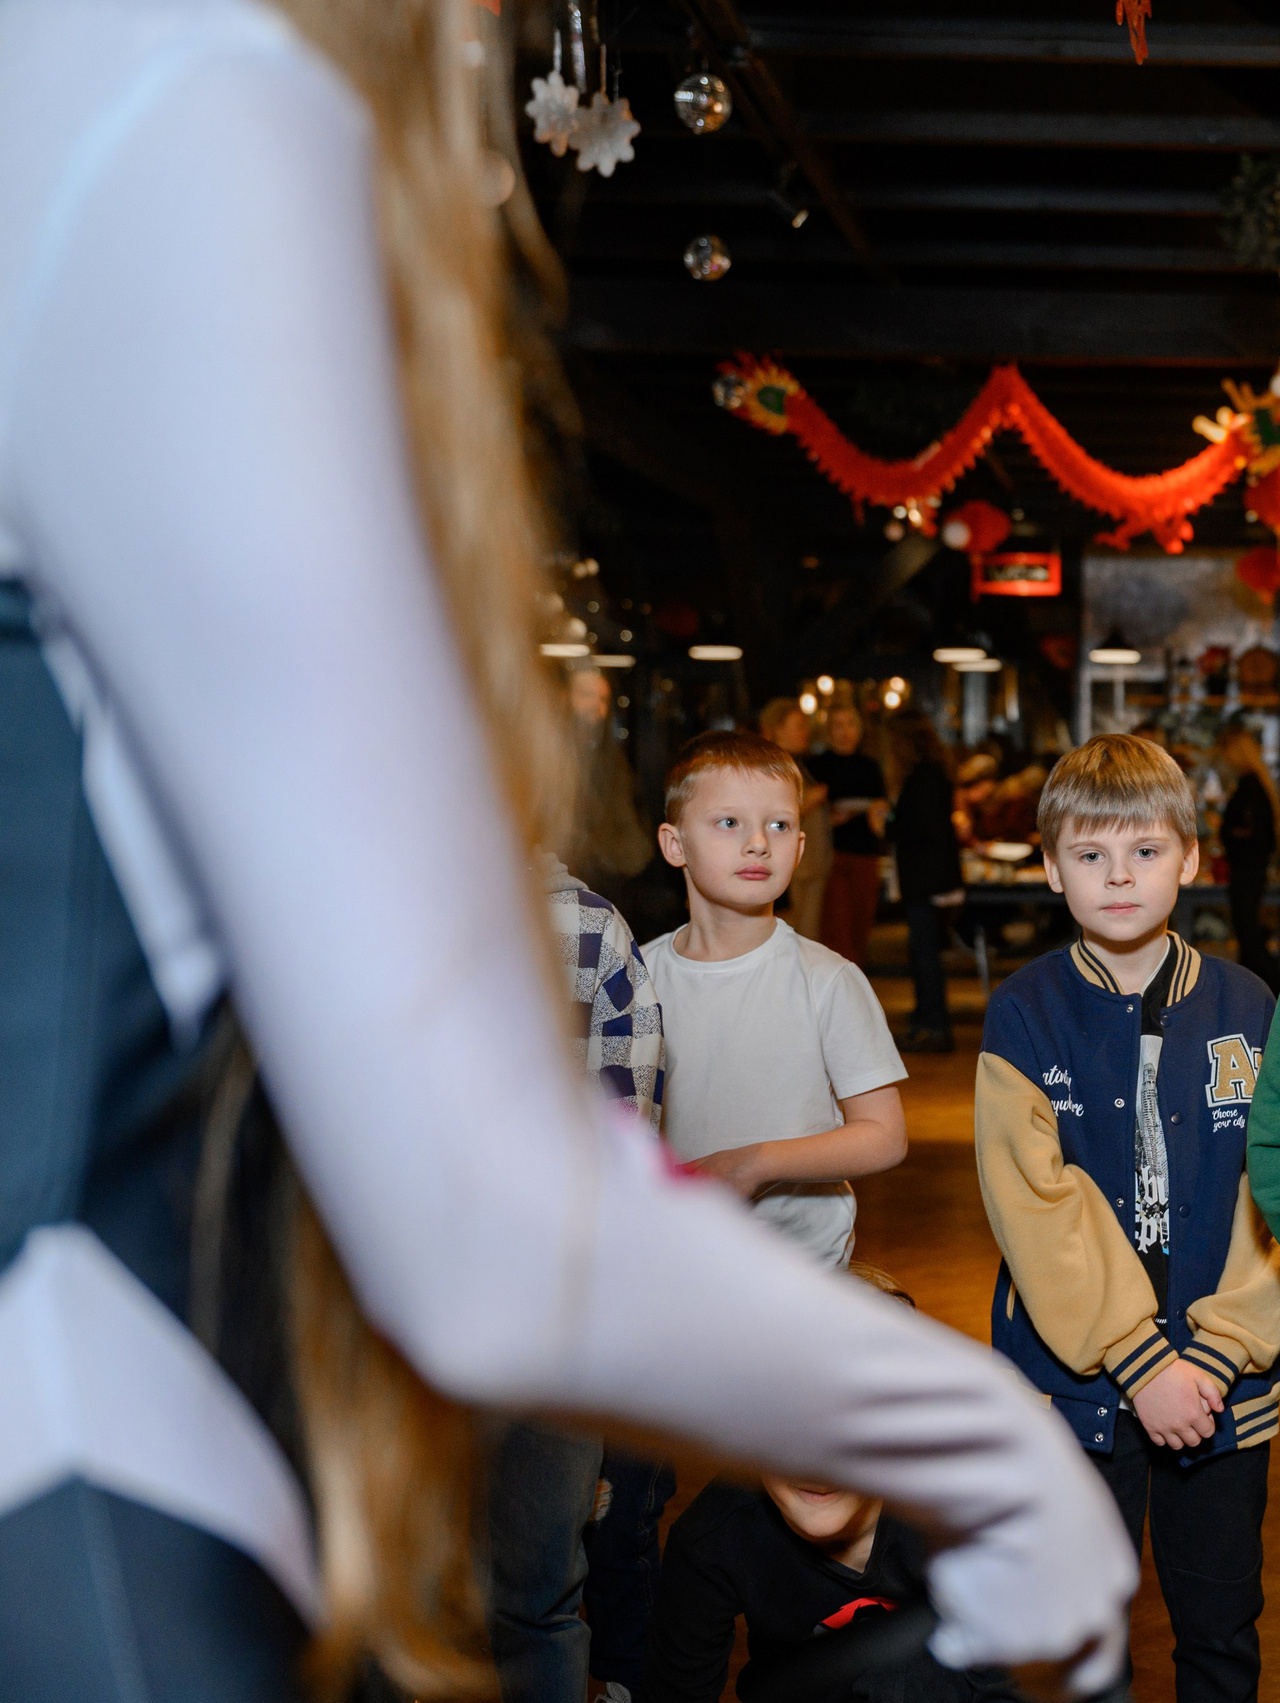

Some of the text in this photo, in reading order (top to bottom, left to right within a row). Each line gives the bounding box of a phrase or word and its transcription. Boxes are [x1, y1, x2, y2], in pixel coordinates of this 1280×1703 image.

[1205, 1033, 1262, 1108] A
[1212, 1107, 1239, 1120] Choose
[1213, 1119, 1232, 1133] your
